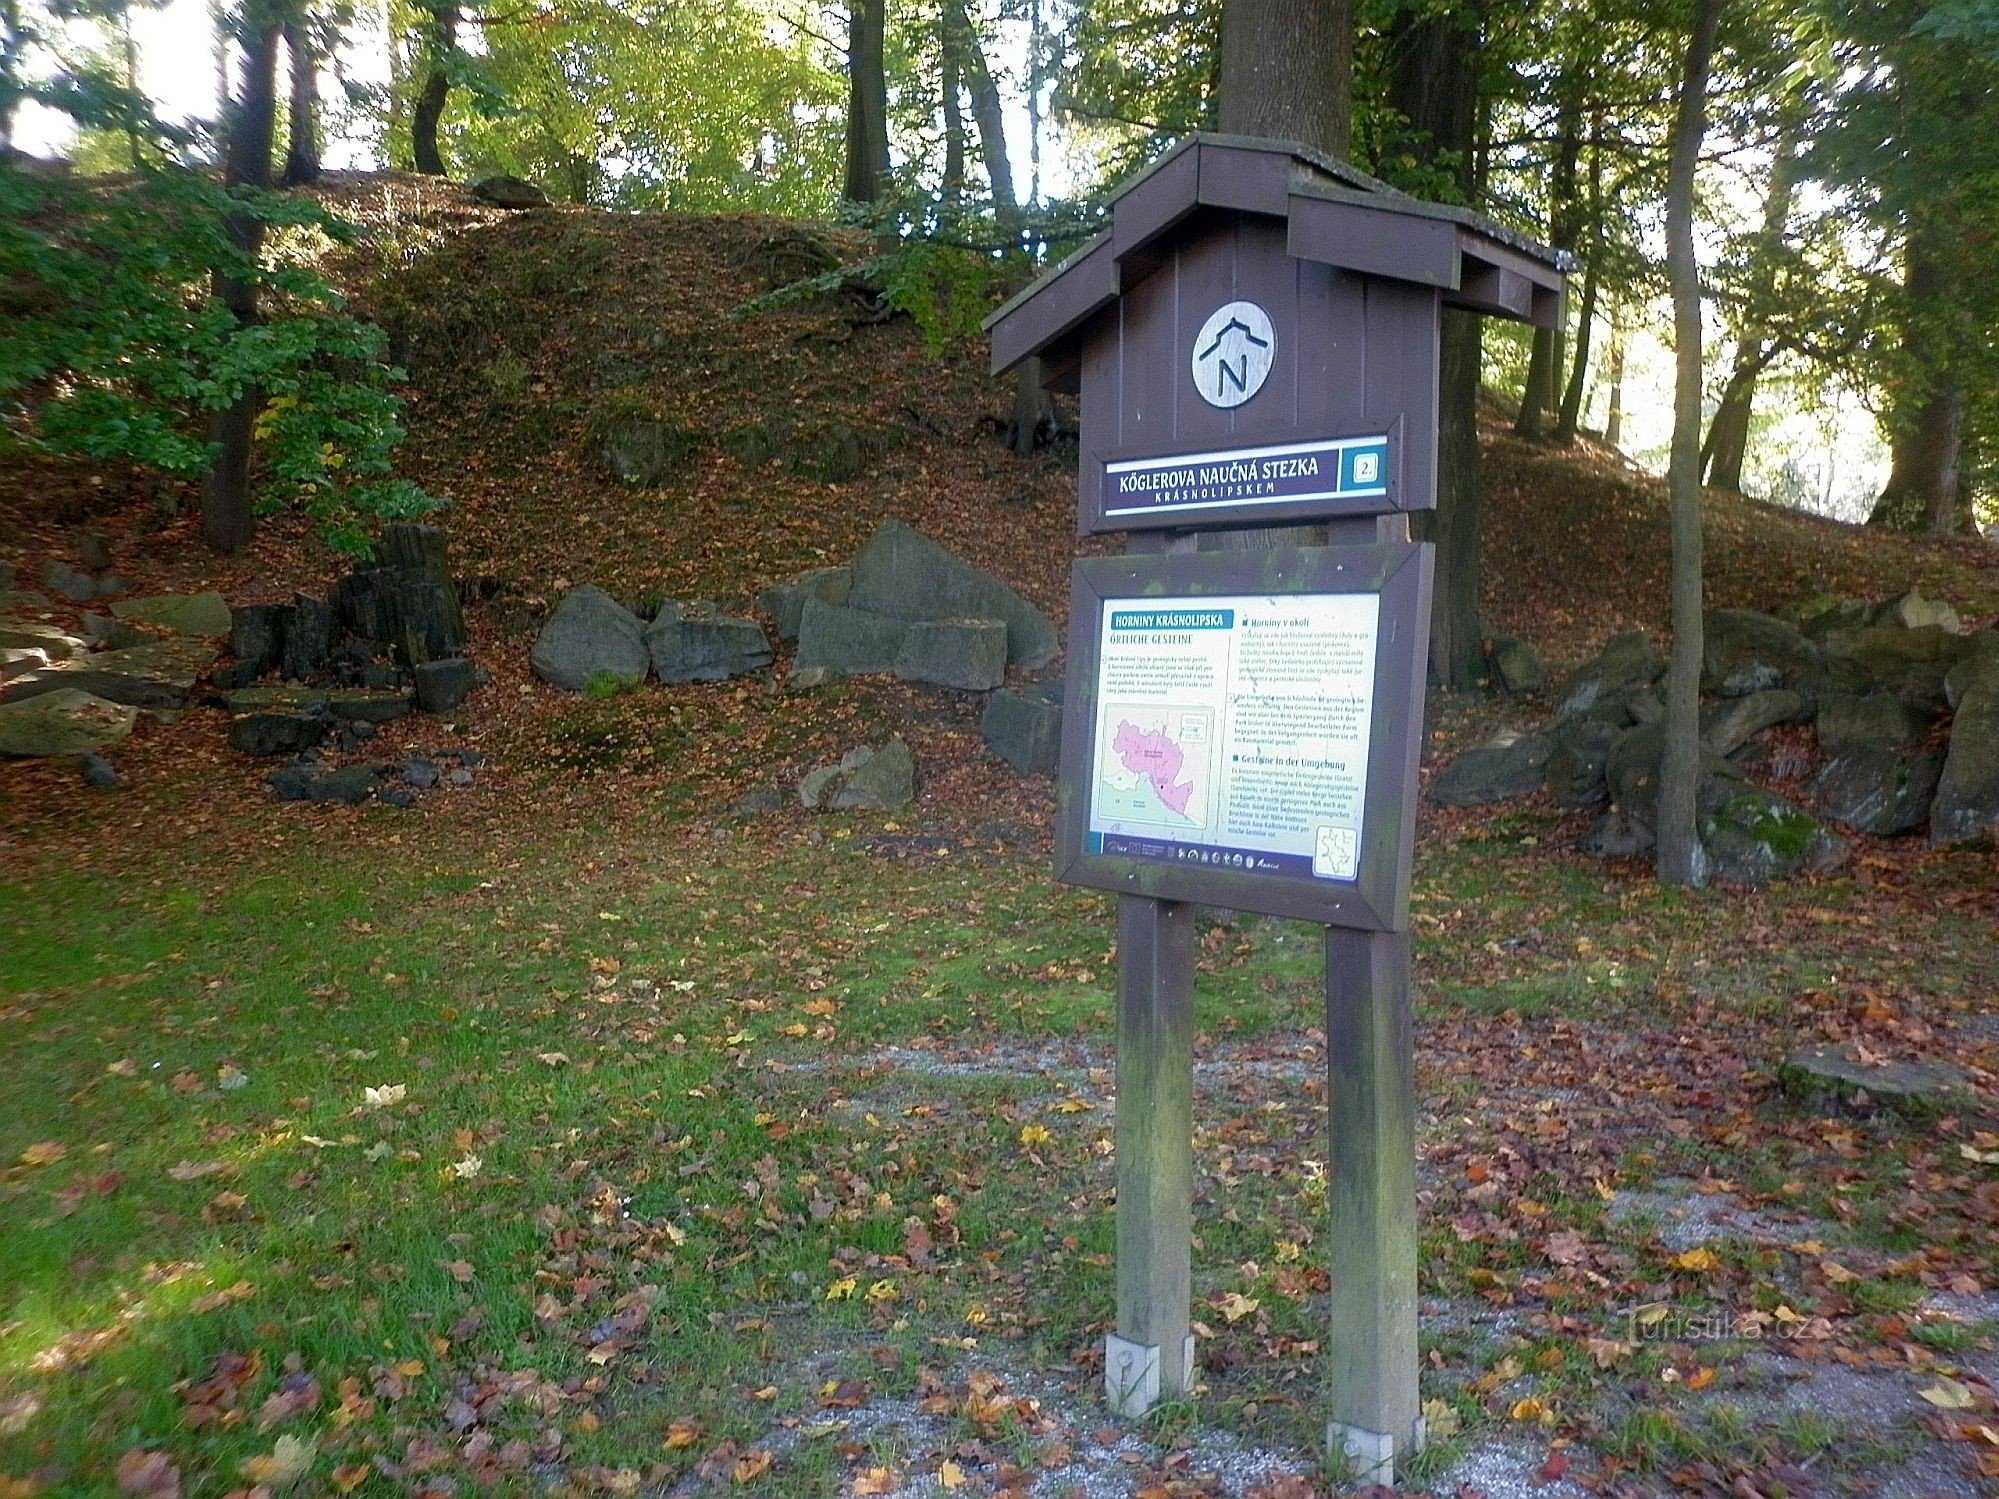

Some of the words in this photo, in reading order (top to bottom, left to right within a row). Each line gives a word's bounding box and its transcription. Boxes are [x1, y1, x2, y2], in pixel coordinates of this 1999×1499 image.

[1119, 470, 1196, 493] KÖGLEROVA
[1199, 459, 1258, 486] NAUČNÁ
[1262, 457, 1319, 480] STEZKA
[1155, 482, 1275, 503] KRÁSNOLIPSKEM
[1115, 615, 1155, 627] HORNINY
[1156, 612, 1224, 627] KRÁSNOLIPSKA
[1251, 619, 1281, 630] Horniny
[1152, 634, 1193, 645] GESTEINE
[1276, 756, 1284, 766] in
[1286, 756, 1299, 766] der
[1301, 758, 1346, 771] Umgebung
